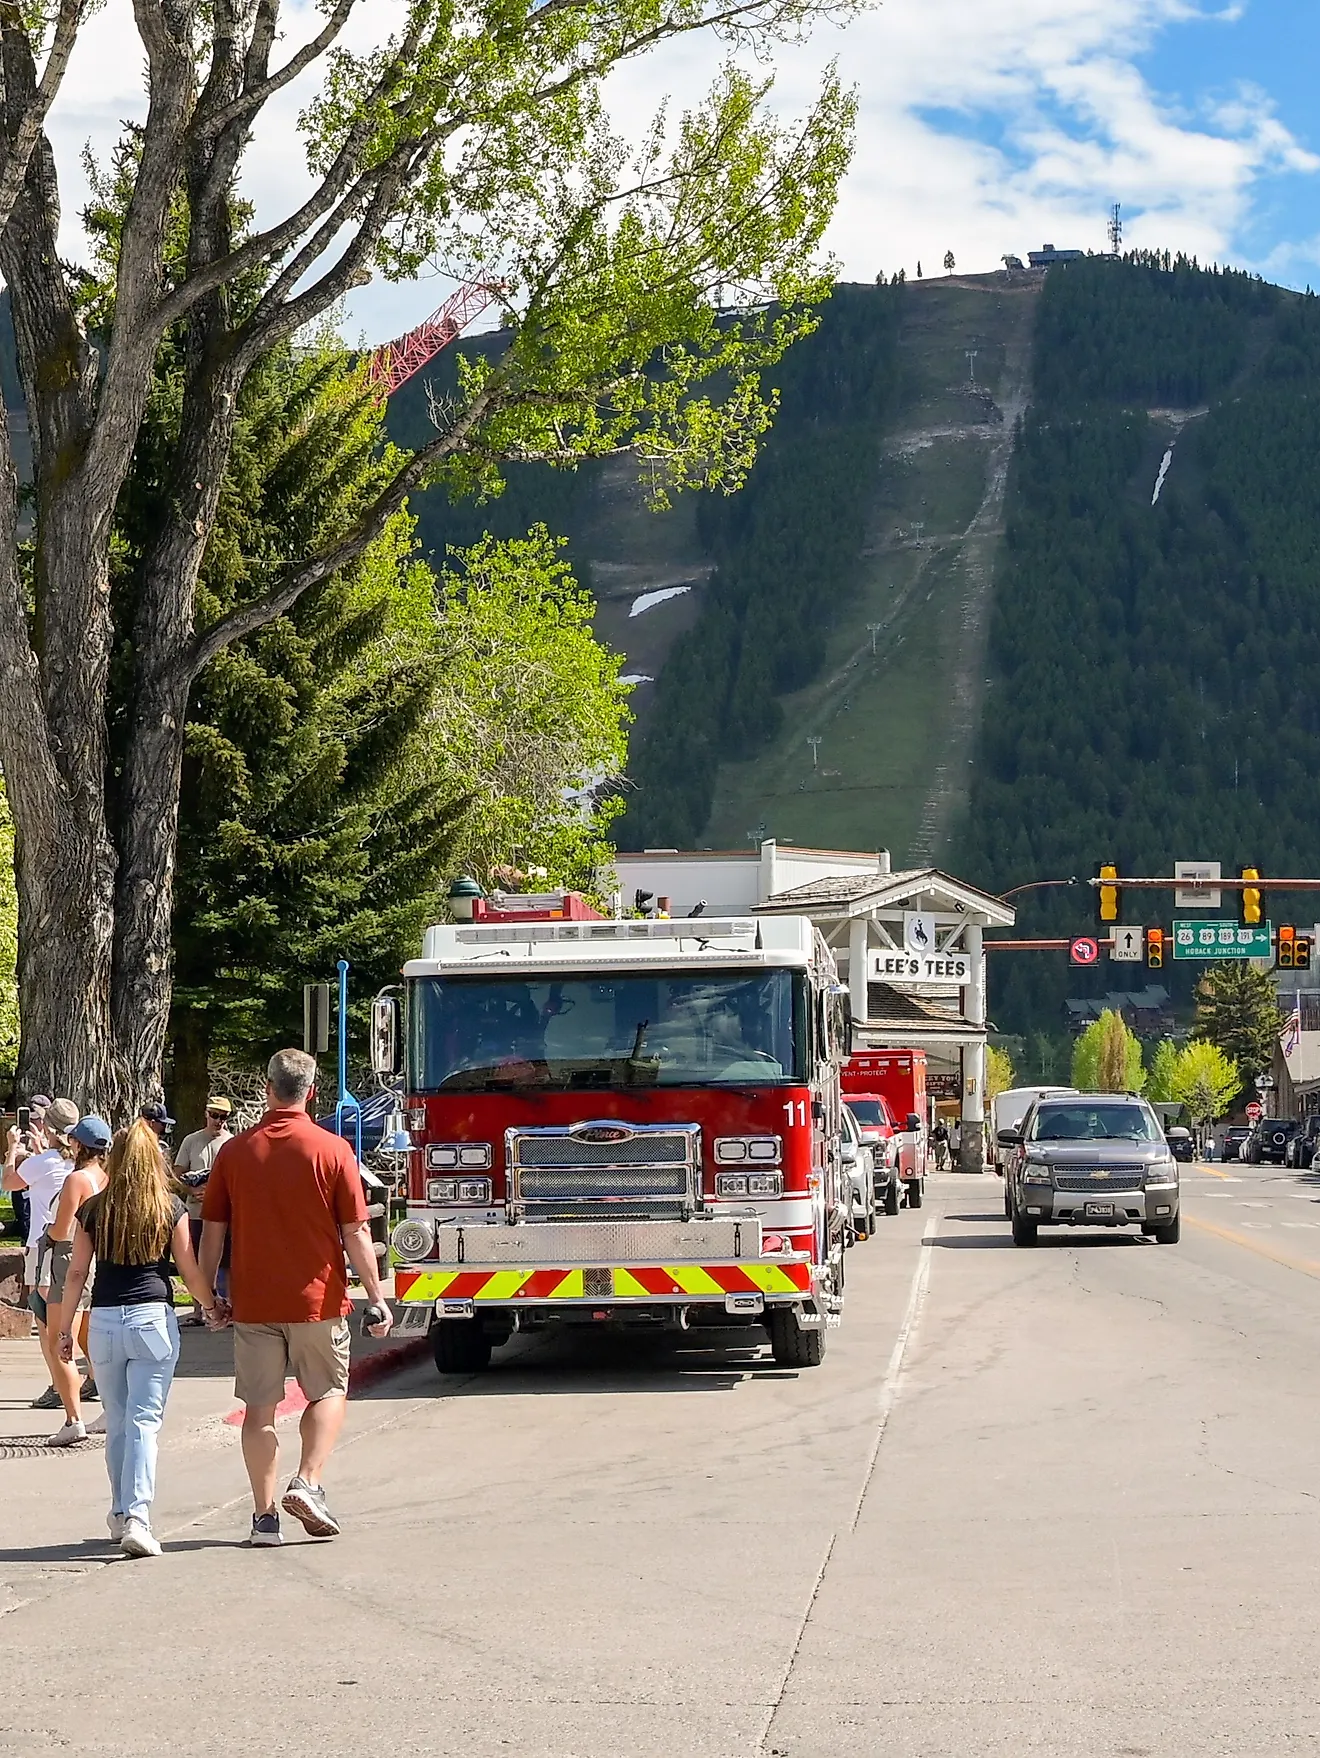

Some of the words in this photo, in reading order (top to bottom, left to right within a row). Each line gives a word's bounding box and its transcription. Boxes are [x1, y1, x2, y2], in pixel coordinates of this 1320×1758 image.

[1180, 932, 1191, 941] 26
[1202, 932, 1212, 941] 89
[1220, 932, 1231, 940] 189
[1240, 931, 1250, 940] 191
[1118, 950, 1138, 958] ONLY
[1214, 947, 1246, 955] JUNCTION
[875, 957, 919, 974] LEE'S
[925, 960, 965, 977] TEES
[782, 1100, 806, 1127] 11
